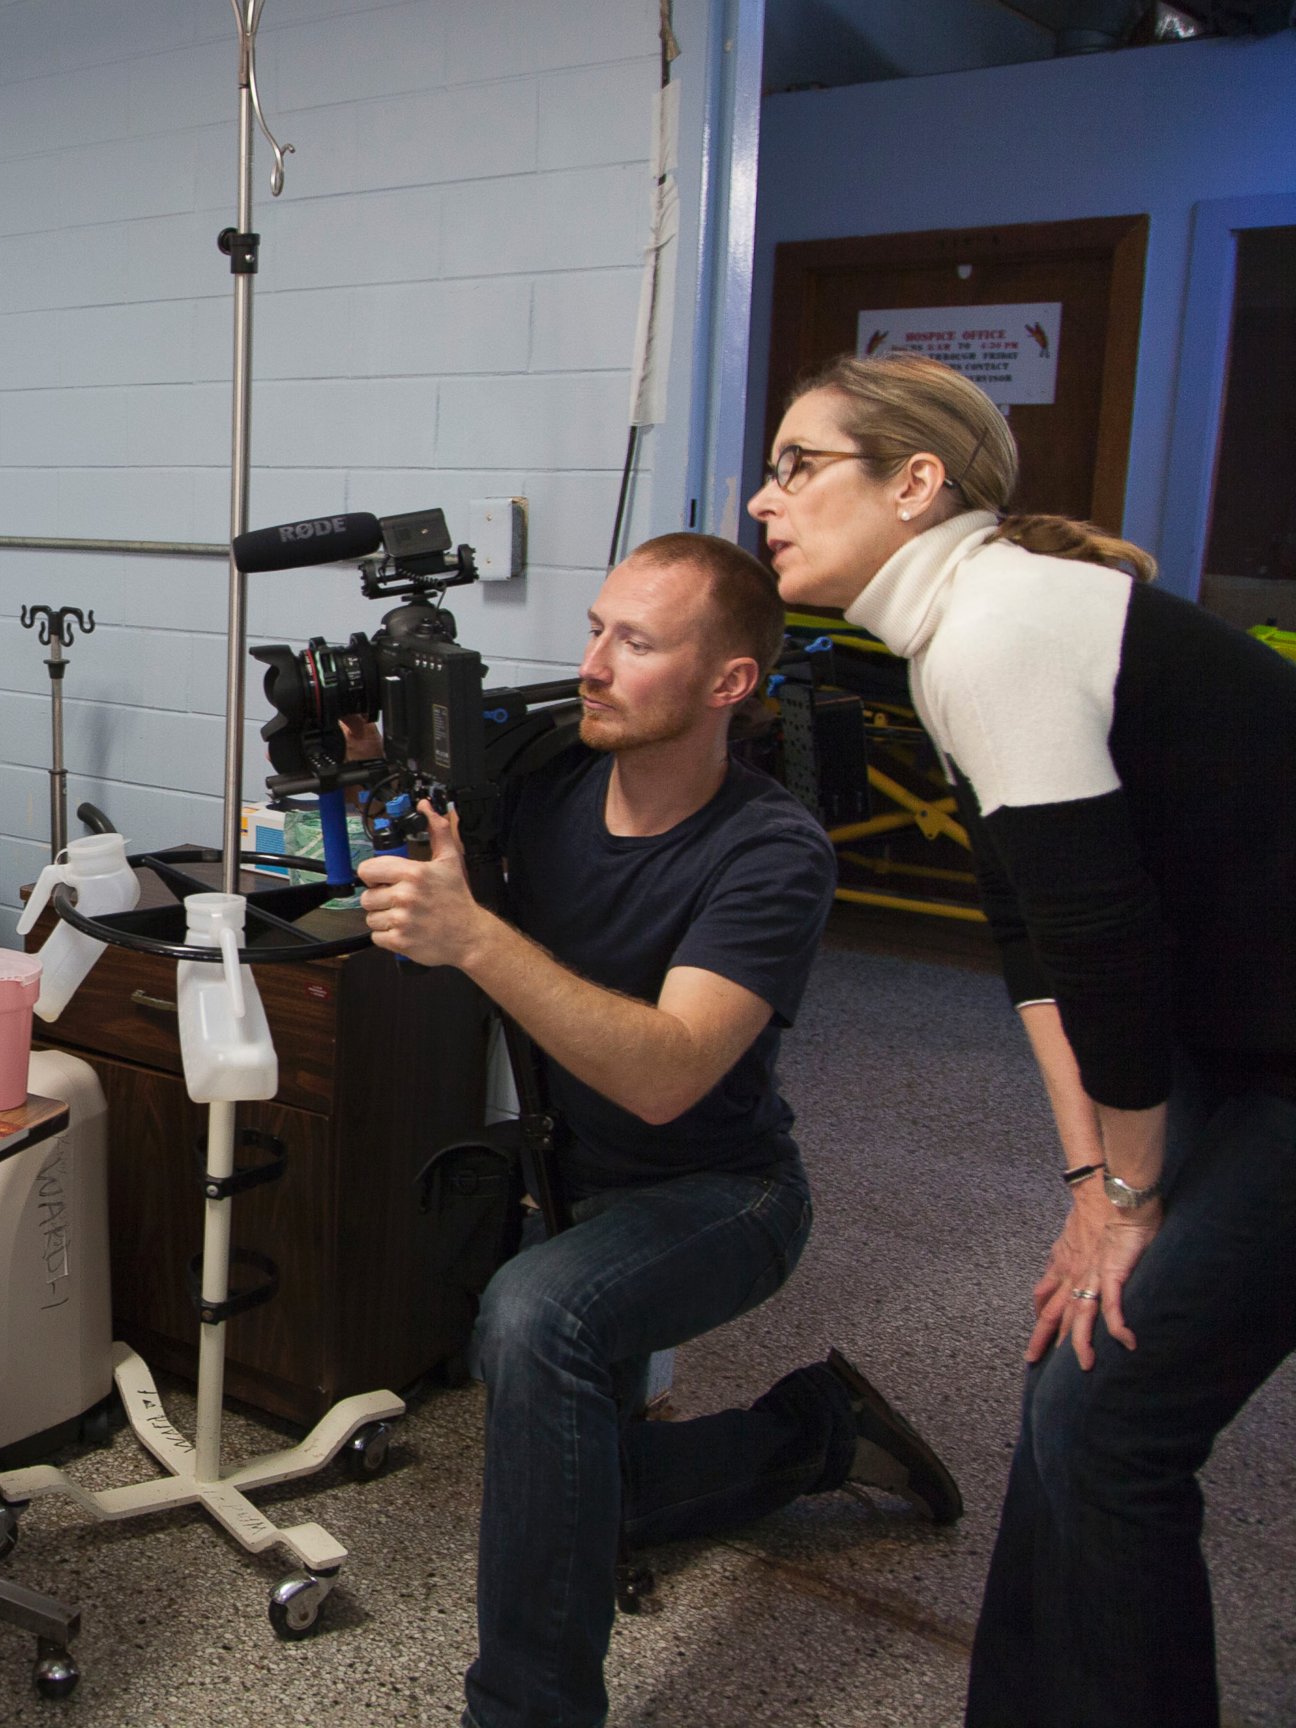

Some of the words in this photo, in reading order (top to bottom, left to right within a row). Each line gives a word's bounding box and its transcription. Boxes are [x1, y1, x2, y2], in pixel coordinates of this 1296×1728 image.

[906, 331, 955, 342] HOSPICE
[962, 329, 1006, 340] OFFICE
[983, 352, 1018, 360] FRIDAY
[279, 517, 346, 543] RØDE
